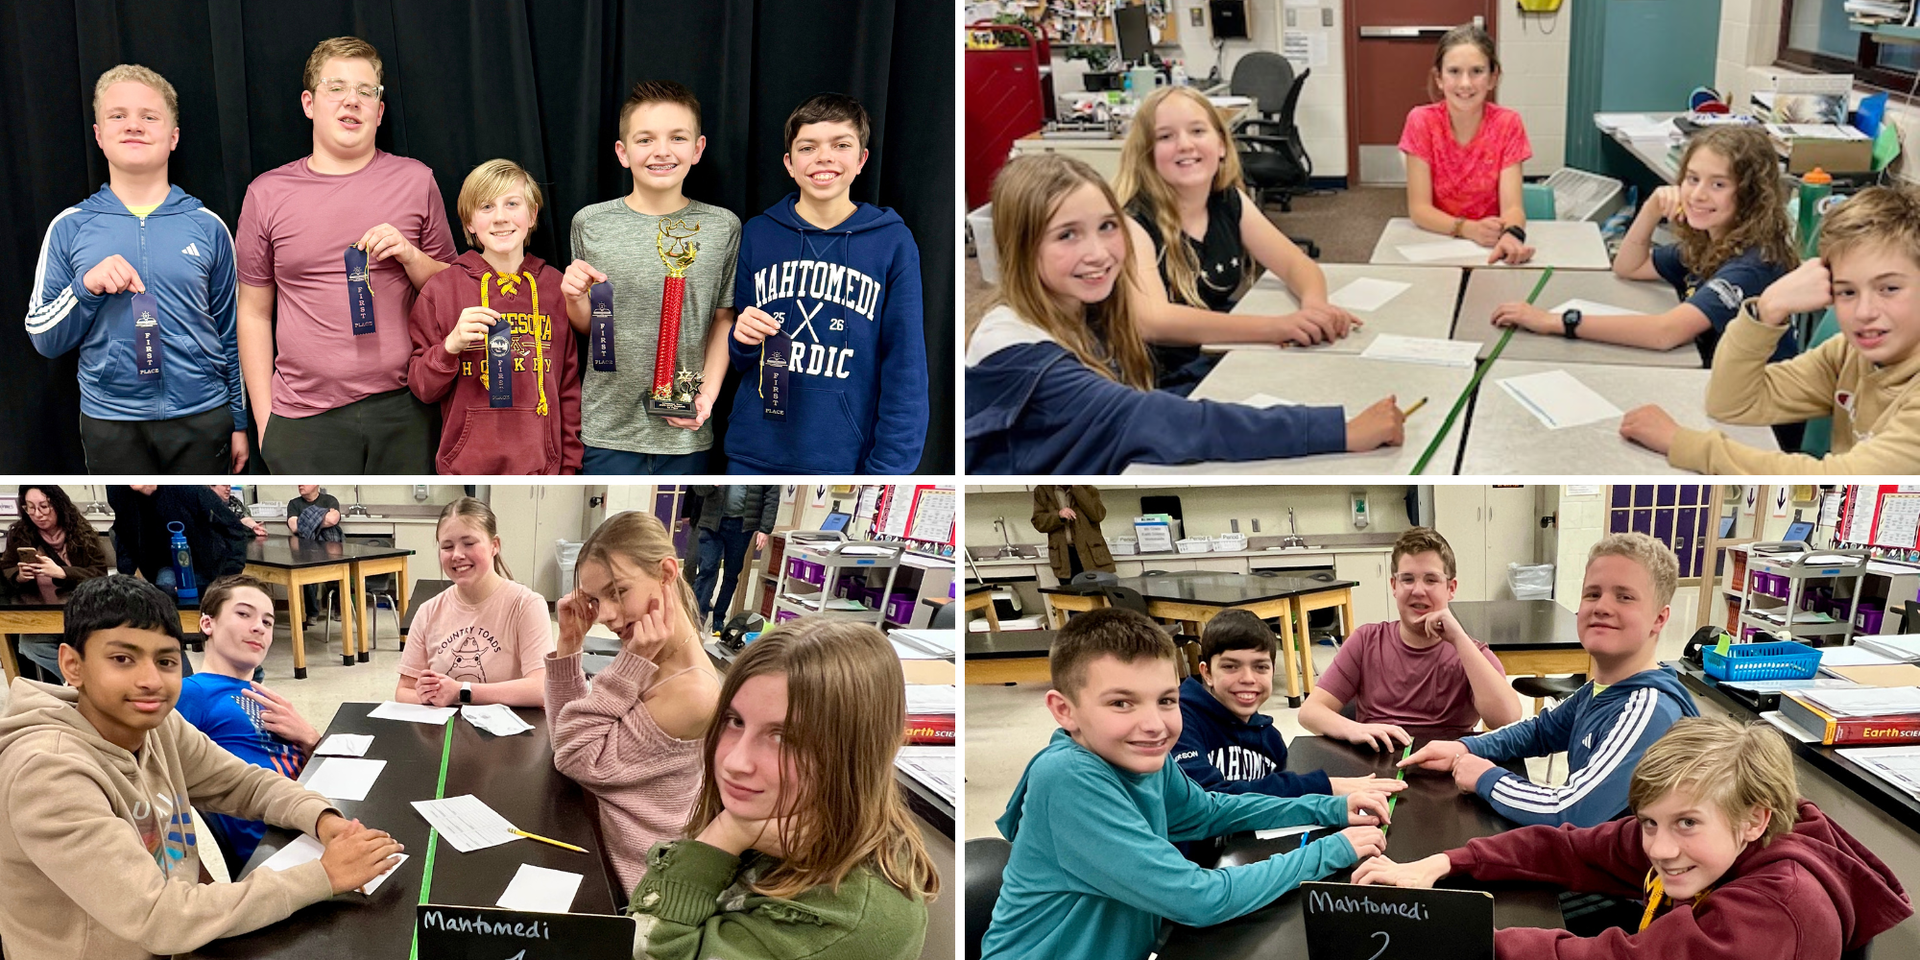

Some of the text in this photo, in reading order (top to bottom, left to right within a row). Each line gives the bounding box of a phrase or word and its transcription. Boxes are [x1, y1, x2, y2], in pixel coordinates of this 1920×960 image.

[357, 286, 366, 319] FIRST
[754, 260, 881, 321] MAHTOMEDI
[829, 318, 844, 331] 26
[144, 332, 153, 366] FIRST
[788, 341, 854, 379] RDIC
[765, 408, 785, 416] PLACE
[437, 626, 501, 655] COUNTRY TOADS
[1863, 727, 1899, 737] Earth
